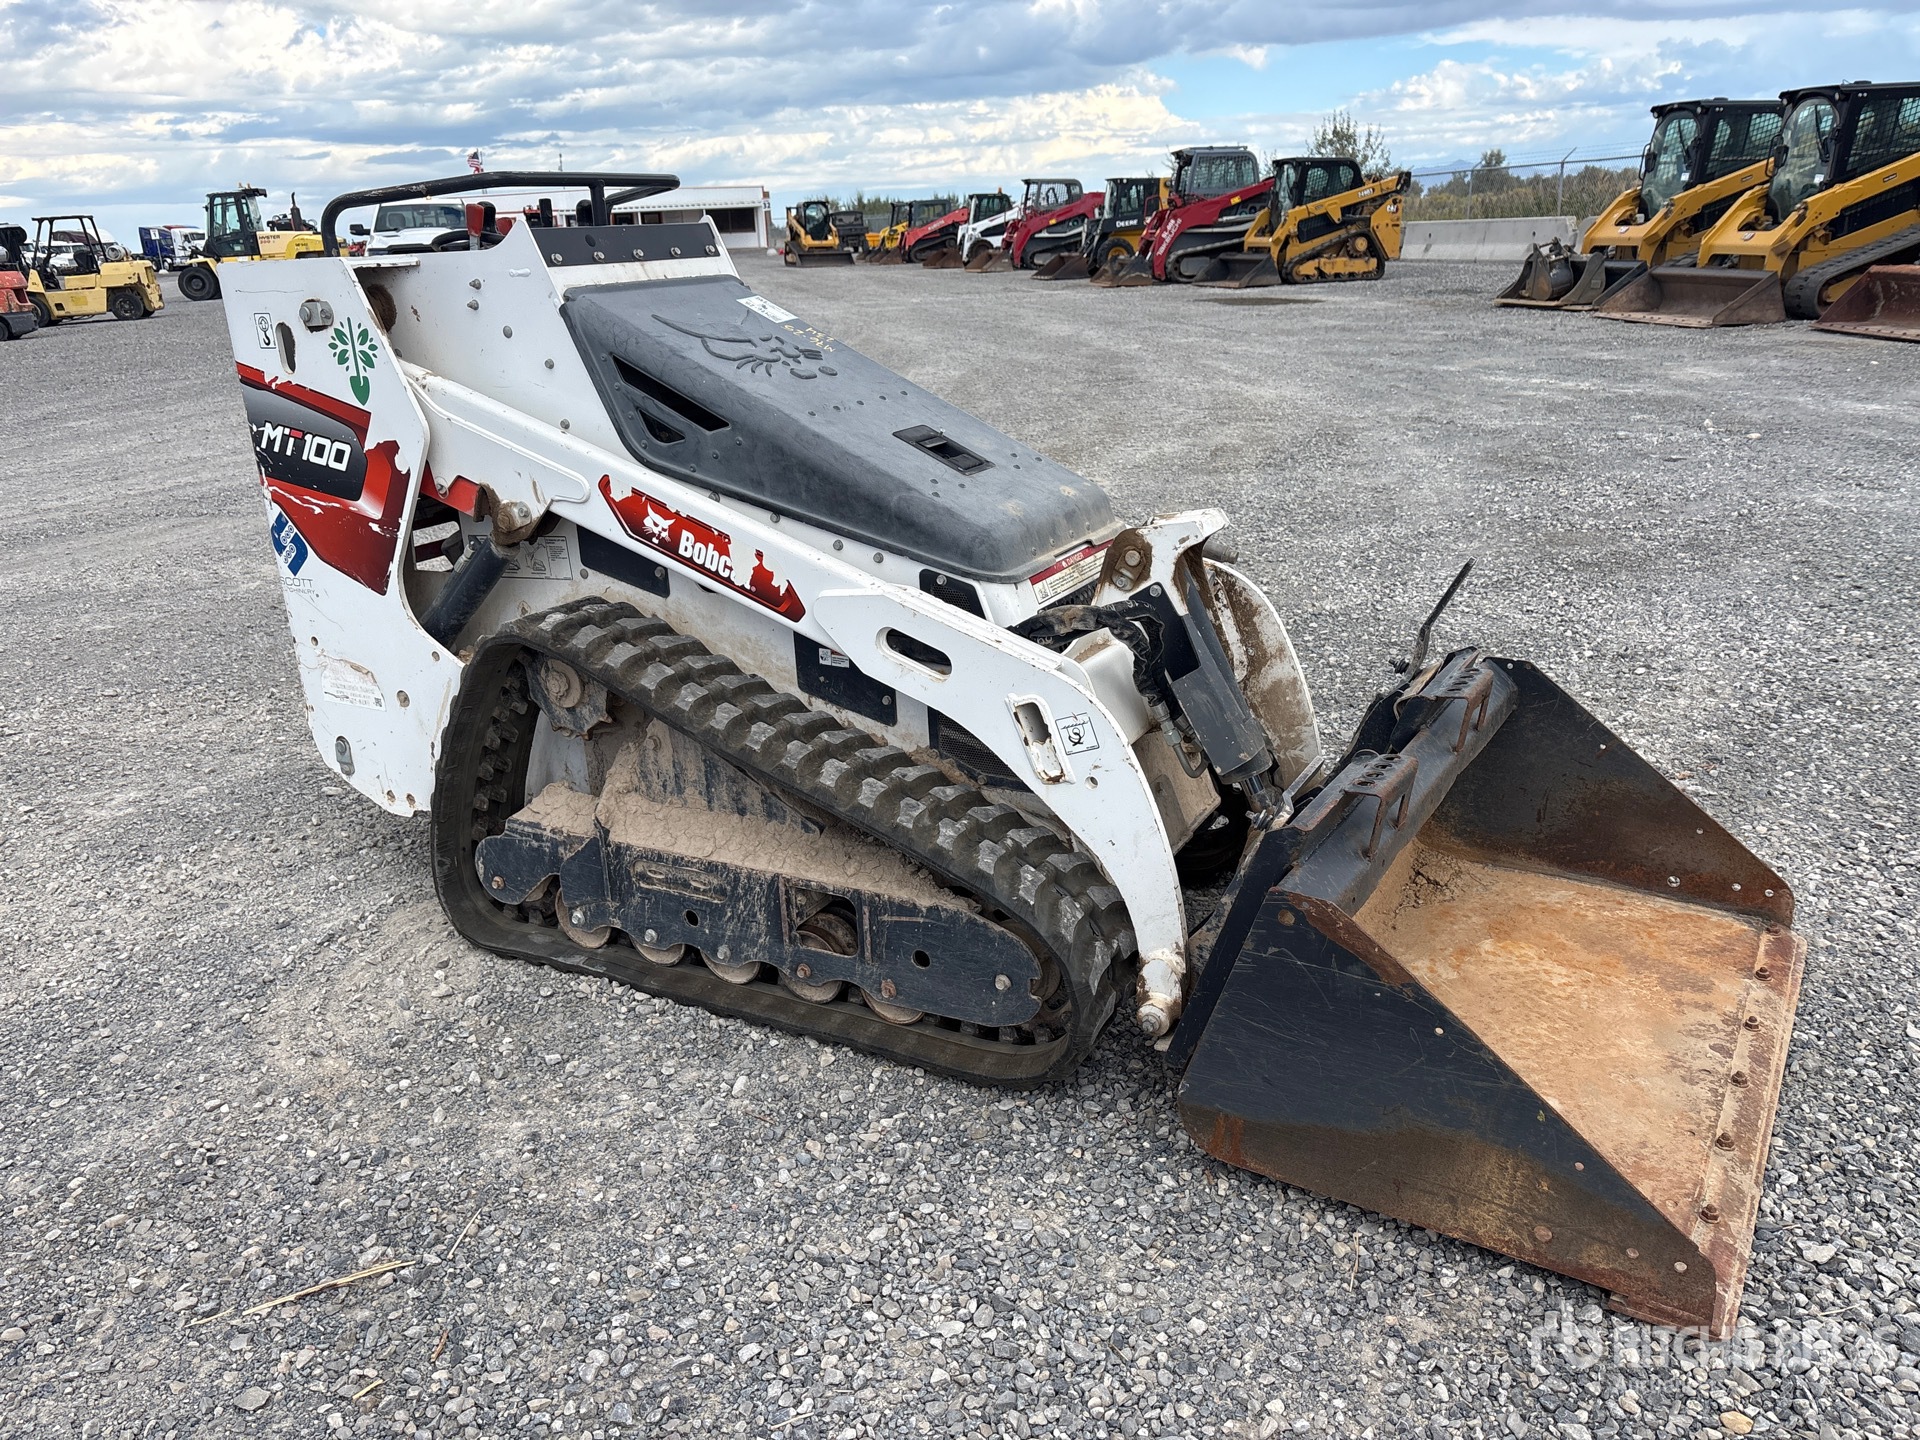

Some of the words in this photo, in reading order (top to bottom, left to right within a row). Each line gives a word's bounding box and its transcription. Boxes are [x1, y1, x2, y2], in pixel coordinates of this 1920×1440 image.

[1116, 219, 1138, 228] DEERE
[260, 420, 352, 472] MT100
[678, 529, 751, 590] Bobc
